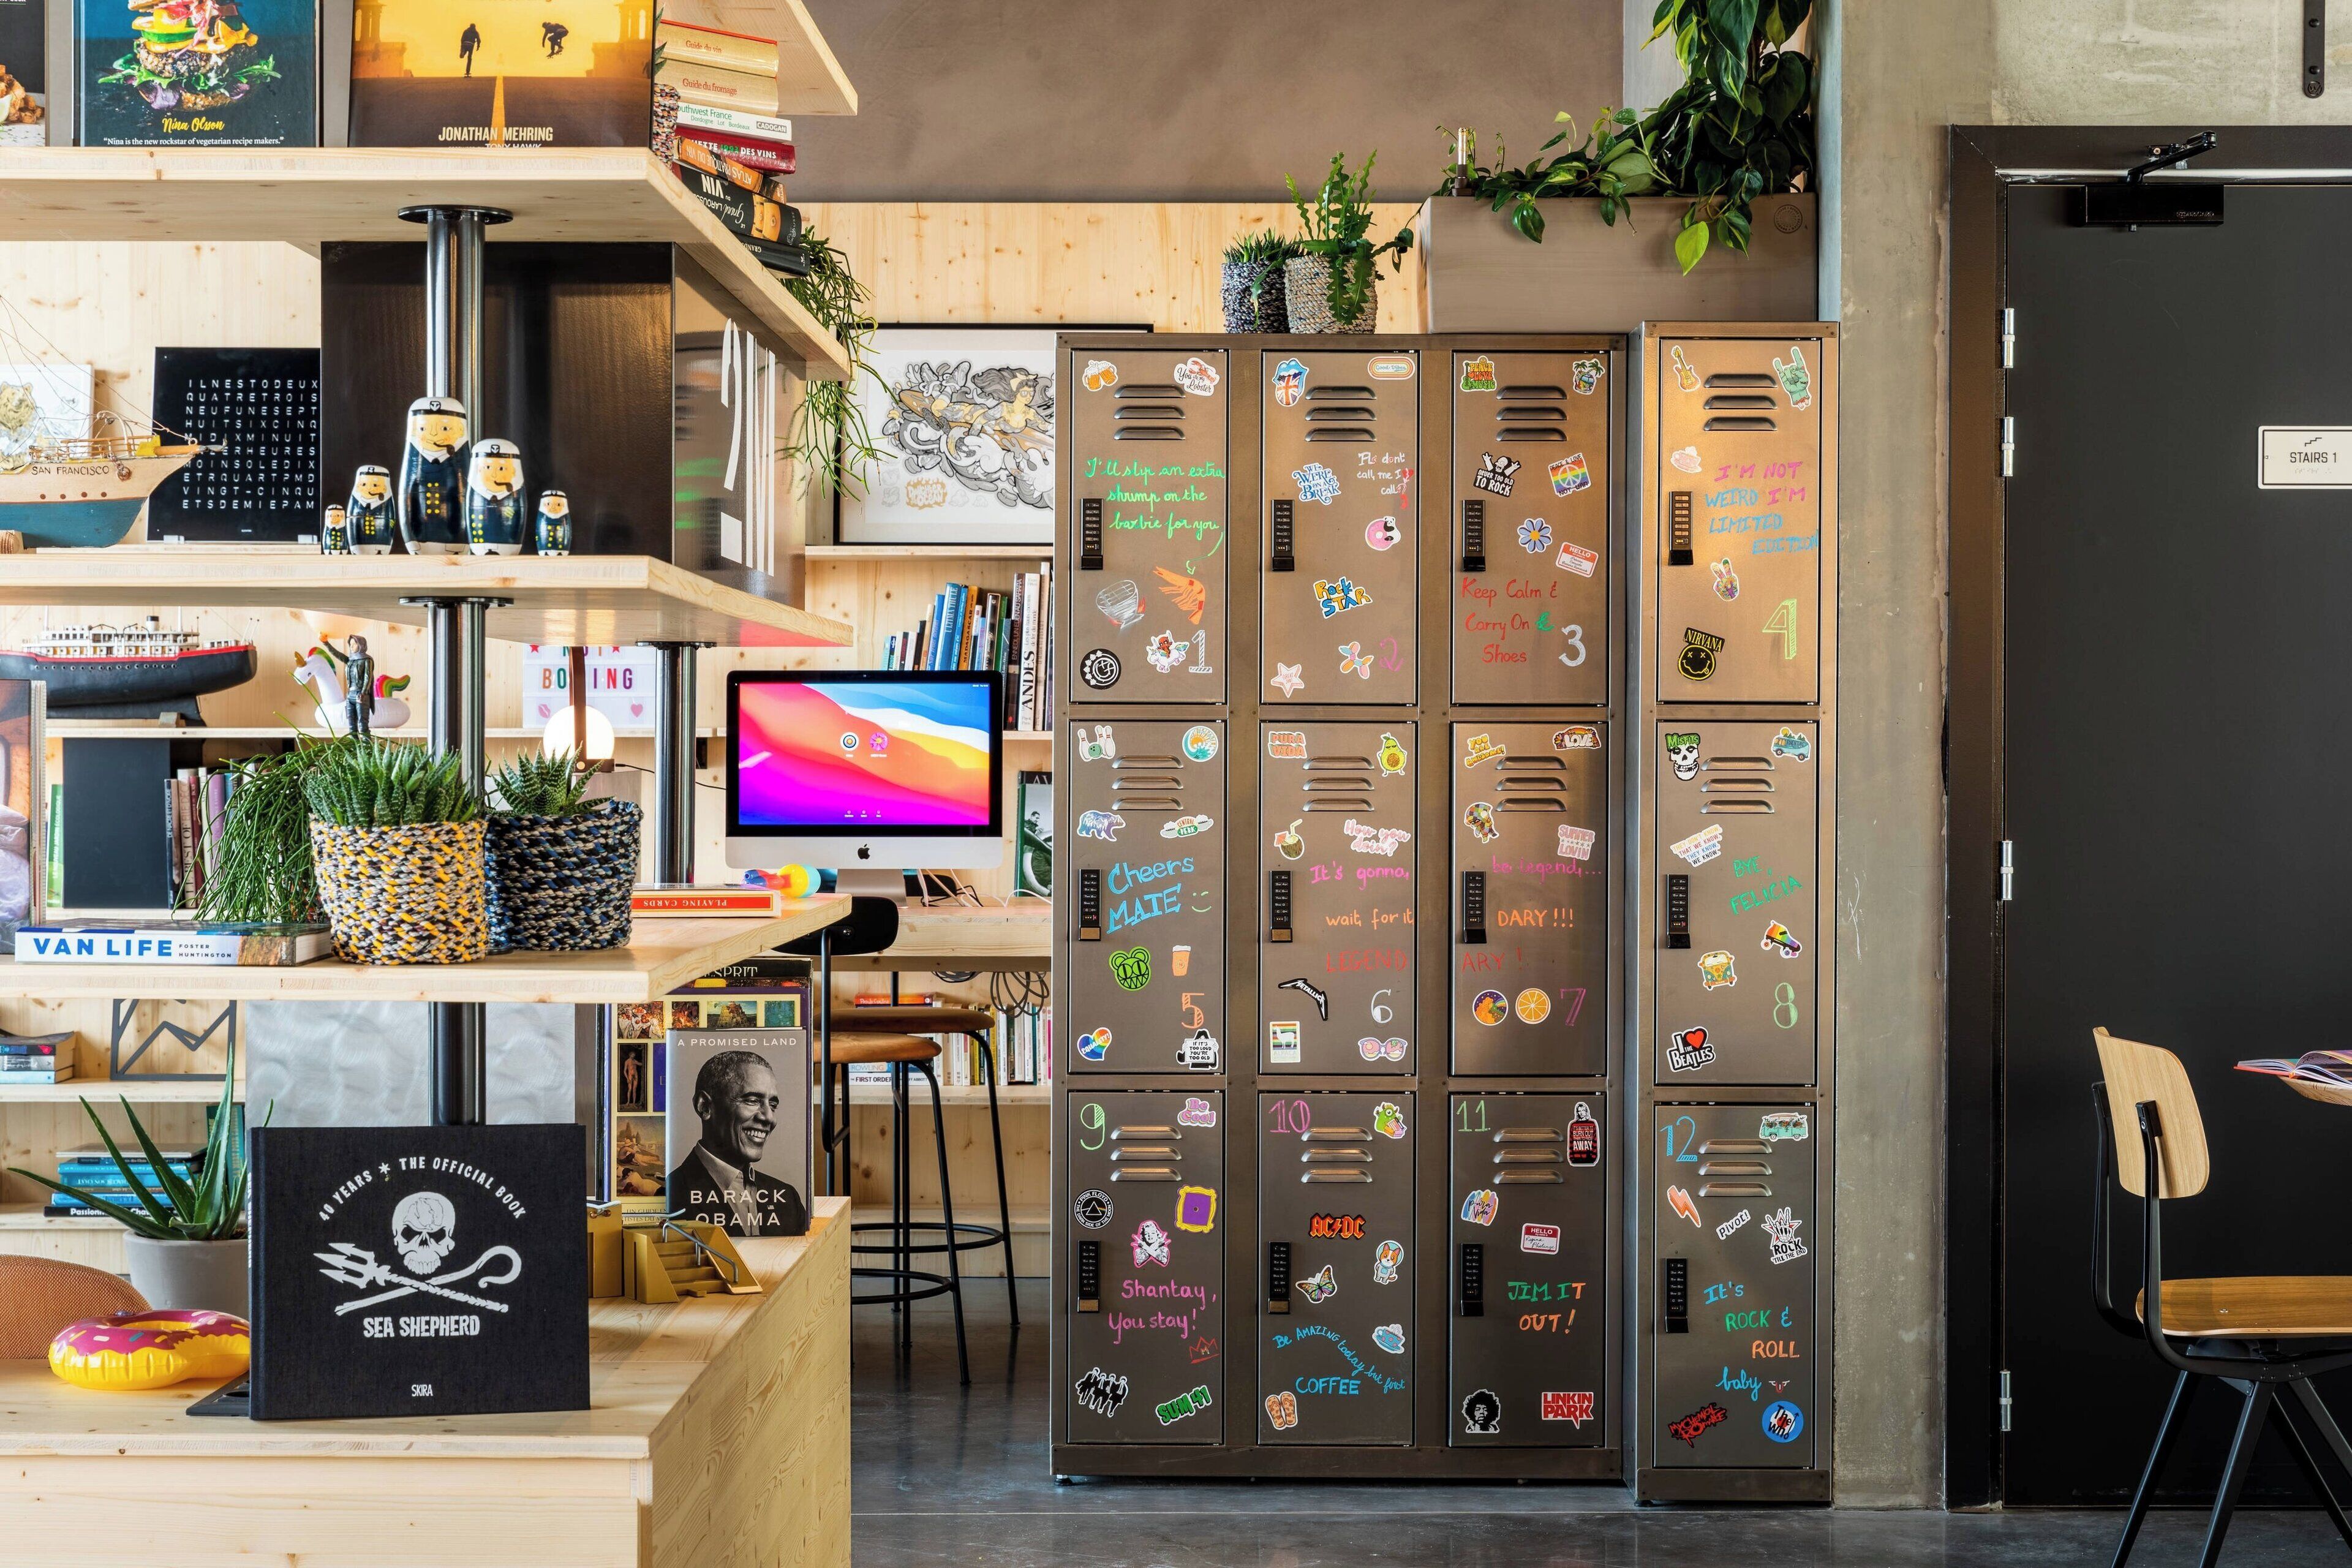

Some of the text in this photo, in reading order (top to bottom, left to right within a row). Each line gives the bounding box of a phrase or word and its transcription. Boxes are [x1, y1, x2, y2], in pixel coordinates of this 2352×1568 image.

[685, 40, 703, 50] Guide
[712, 45, 722, 54] vin
[682, 78, 737, 97] Guide du fromage
[162, 116, 225, 133] Nina Olsson
[691, 115, 714, 124] Dordogne
[728, 121, 750, 130] Bordeaux
[757, 122, 787, 133] CADOGAN
[439, 127, 553, 141] JONATHAN MEHRING
[686, 145, 752, 185] ATLAS PRATIQUE DU VIN
[701, 173, 724, 198] VIN
[1186, 379, 1212, 393] Lobster
[1474, 372, 1493, 381] LOVE
[2290, 451, 2337, 463] STAIRS 1
[31, 465, 110, 476] SAN FRANCISCO
[1085, 457, 1225, 486] I'll slip an extra
[1714, 461, 1803, 482] I'M NOT
[1475, 475, 1512, 496] TO ROCK
[1106, 483, 1207, 513] shrimp on the
[1705, 486, 1806, 508] WEIRD I'M
[1709, 513, 1784, 534] LIMITED
[1569, 546, 1591, 558] HELLO
[1322, 589, 1371, 617] STAR
[1461, 576, 1497, 608] Keep
[1506, 578, 1541, 599] Calm
[944, 586, 959, 633] ULTIMA THULE
[963, 609, 973, 663] MADAGASCAR
[1762, 598, 1798, 660] 4
[1189, 629, 1212, 673] 1
[1558, 624, 1586, 668] 3
[1685, 629, 1723, 654] NIRVANA
[1380, 636, 1404, 672] 2
[1482, 643, 1528, 664] Shoes
[542, 668, 633, 690] BOING
[1022, 650, 1035, 710] ANDES
[1271, 734, 1304, 744] PURA
[1469, 735, 1488, 750] YOU
[1564, 733, 1594, 748] LOVE
[1272, 745, 1306, 757] VIDA
[1180, 826, 1196, 835] PERK
[1559, 825, 1595, 843] SUMMER
[1107, 856, 1194, 894] Cheers
[1728, 875, 1803, 916] FELICIA
[1106, 883, 1182, 935] MATE
[33, 938, 172, 957] VAN LIFE
[1326, 947, 1408, 973] LEGEND
[1181, 992, 1205, 1029] 5
[1371, 989, 1393, 1023] 6
[1559, 987, 1586, 1027] 7
[1773, 982, 1798, 1029] 8
[691, 1038, 758, 1047] PROMISED
[763, 1038, 797, 1046] LAND
[1670, 1047, 1713, 1069] BEATLES
[1188, 1099, 1208, 1112] Be
[1268, 1100, 1311, 1133] 10
[1456, 1100, 1491, 1133] 11
[1573, 1140, 1593, 1150] AWAY
[1660, 1115, 1698, 1162] 12
[319, 1156, 527, 1221] 40 YEARS THE OFFICIAL BOOK
[690, 1189, 786, 1204] BARACK
[1079, 1191, 1109, 1202] PINK FLOYD
[695, 1213, 781, 1227] OBAMA
[1773, 1239, 1803, 1256] ROCK
[1507, 1281, 1586, 1302] JIM IT
[1703, 1281, 1744, 1305] It's
[363, 1315, 480, 1338] SEA SHEPHERD
[1109, 1308, 1196, 1344] You stay!
[1519, 1308, 1577, 1334] OUT!
[1752, 1340, 1800, 1359] ROLL
[1272, 1335, 1292, 1349] Be
[1337, 1340, 1365, 1376] today
[1364, 1365, 1383, 1384] but
[1383, 1377, 1406, 1394] first
[411, 1384, 433, 1397] SKIRA
[1295, 1376, 1362, 1395] COFFEE
[1716, 1366, 1762, 1401] baby
[1157, 1385, 1212, 1423] SUM 41
[1543, 1393, 1593, 1404] LINKIN
[1543, 1404, 1594, 1427] PARK
[1777, 1404, 1792, 1426] The
